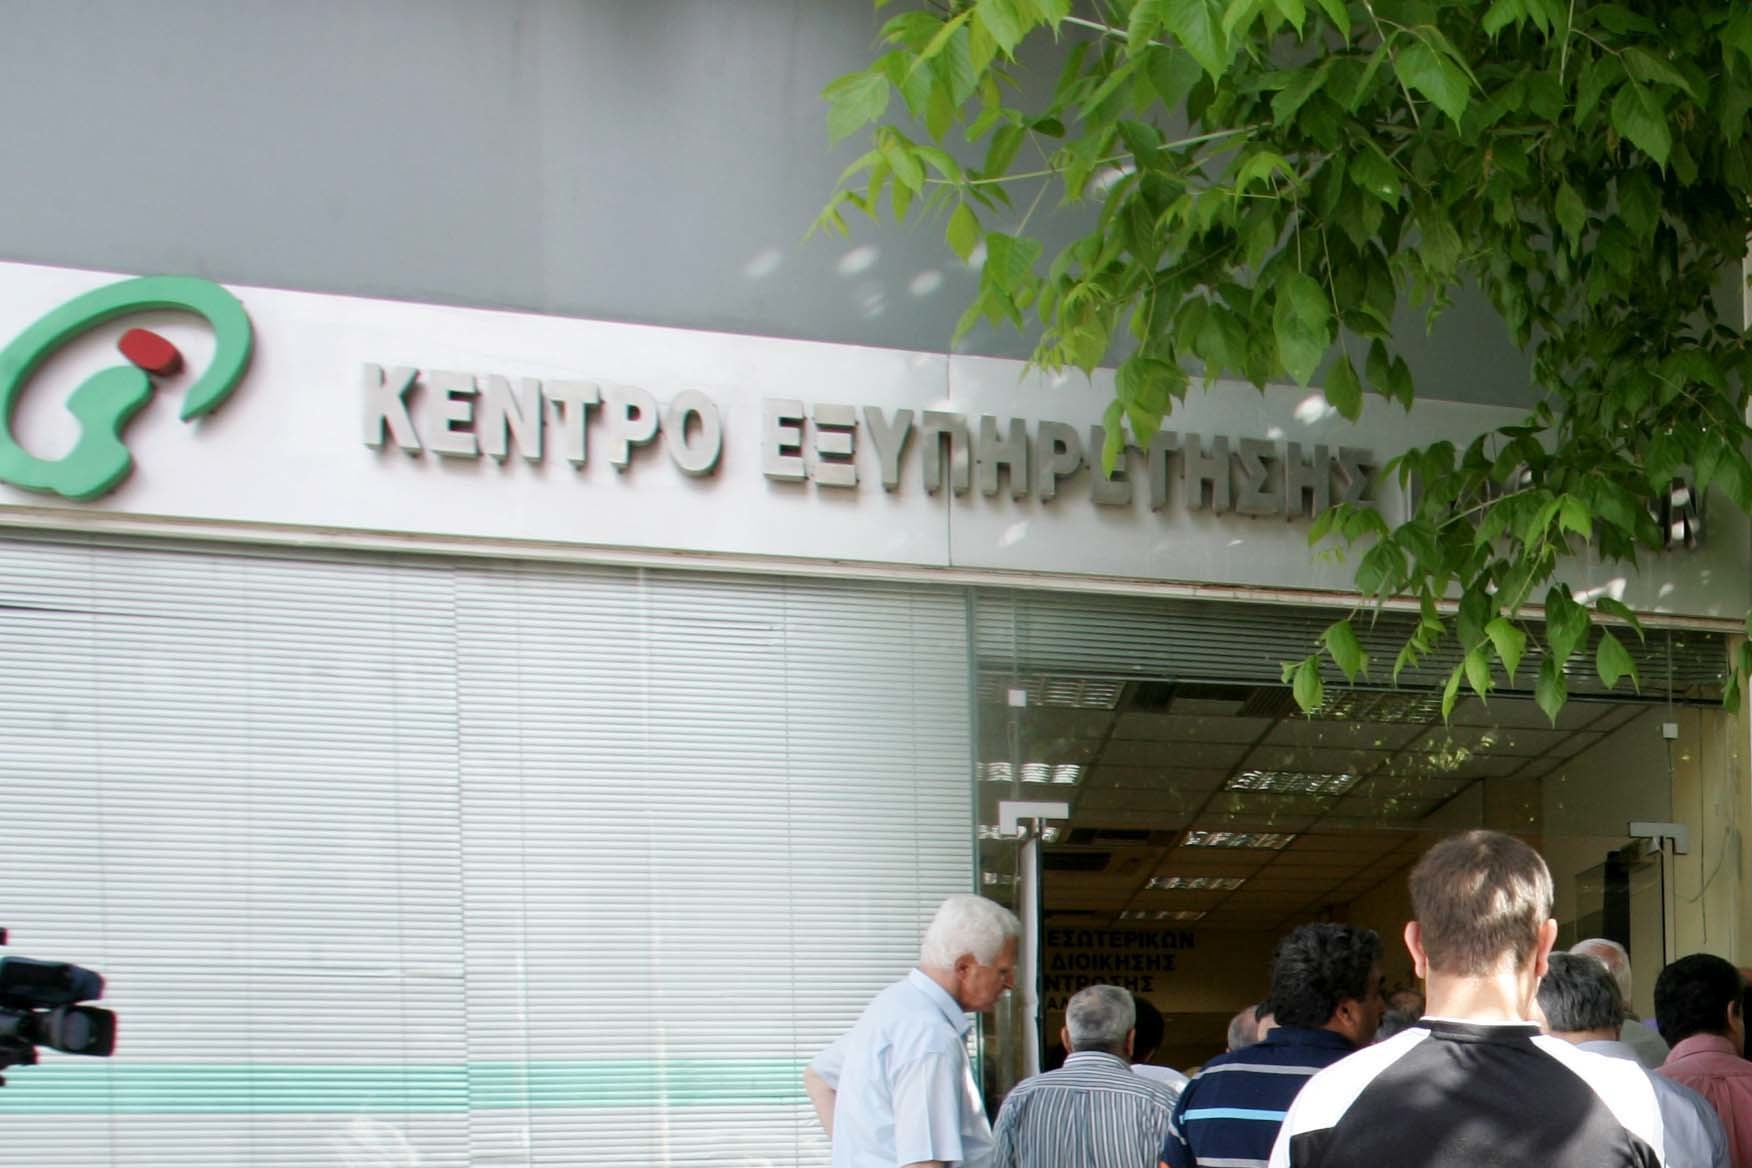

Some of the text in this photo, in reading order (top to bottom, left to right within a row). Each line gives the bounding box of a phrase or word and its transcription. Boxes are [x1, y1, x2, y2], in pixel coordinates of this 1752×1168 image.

[363, 362, 722, 476] ΚΕΝΤΡΟ
[763, 399, 1378, 519] ΕΞΥΠΗΡΕΤΗΣΗΣ
[1047, 929, 1195, 948] ΕΣΩΤΕΡΙΚΩΝ
[1051, 953, 1176, 971] ΔΙΟΙΚΗΣΗΣ
